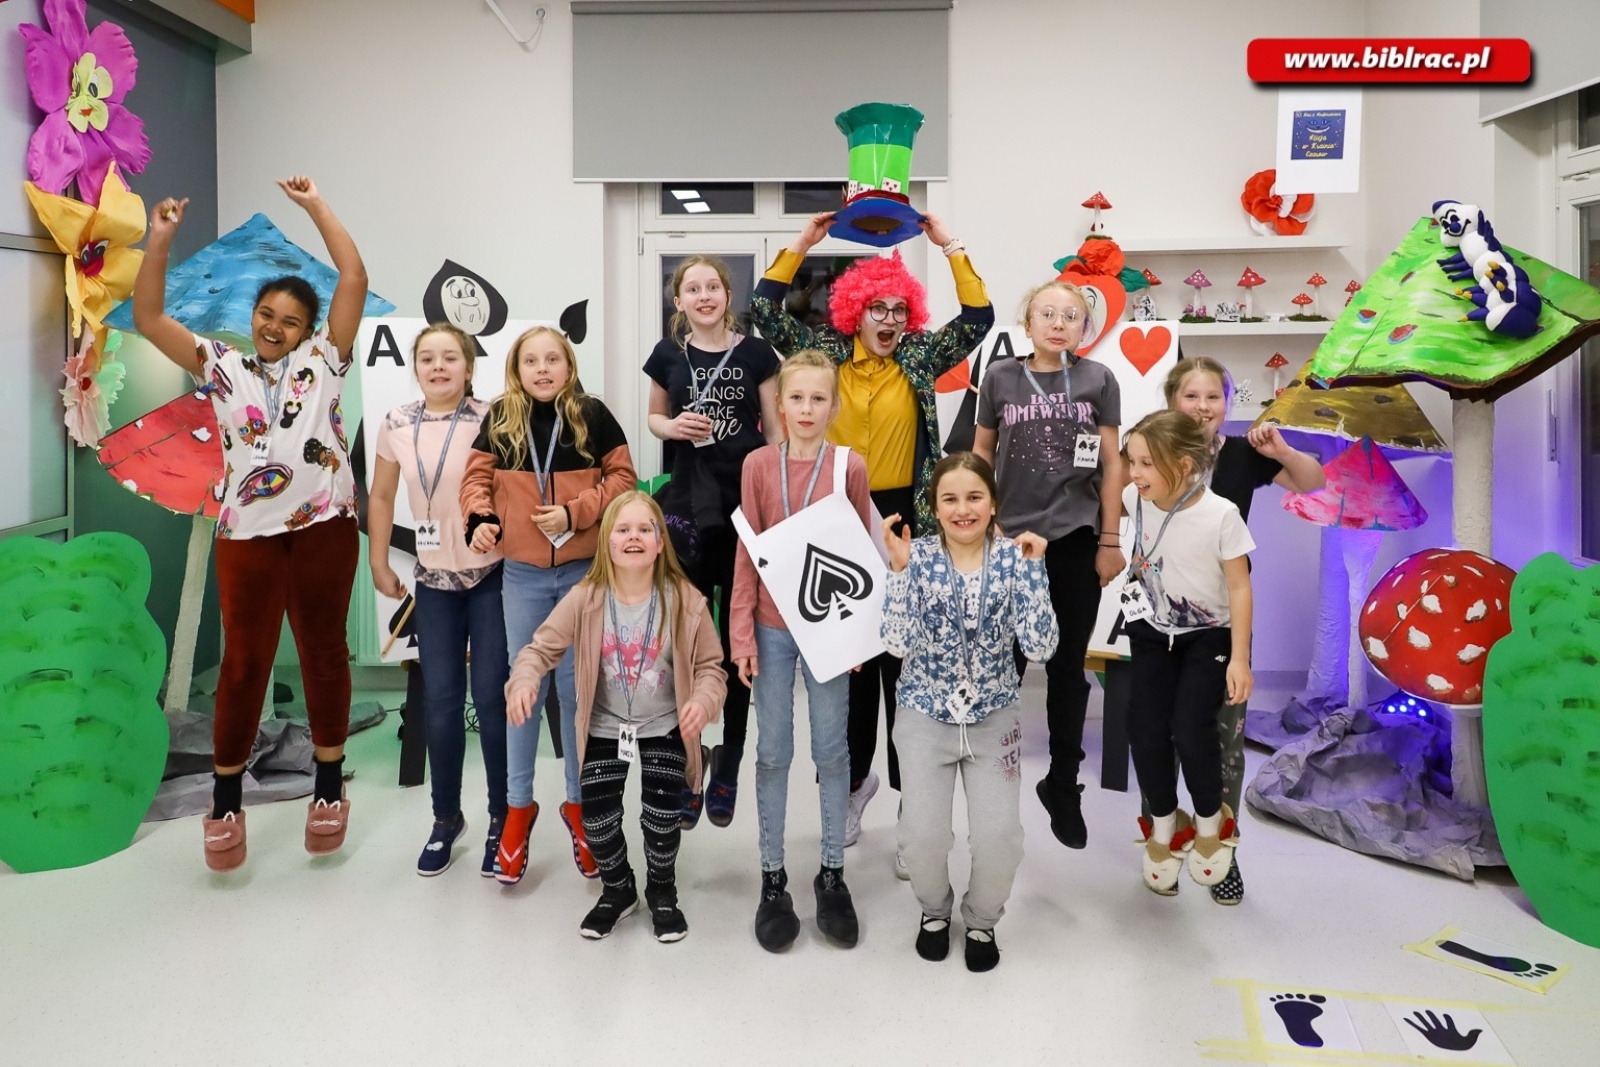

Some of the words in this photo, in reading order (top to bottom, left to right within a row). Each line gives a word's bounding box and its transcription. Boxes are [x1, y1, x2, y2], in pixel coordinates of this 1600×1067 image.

[366, 324, 405, 367] A
[695, 367, 744, 380] GOOD
[686, 386, 745, 400] THINGS
